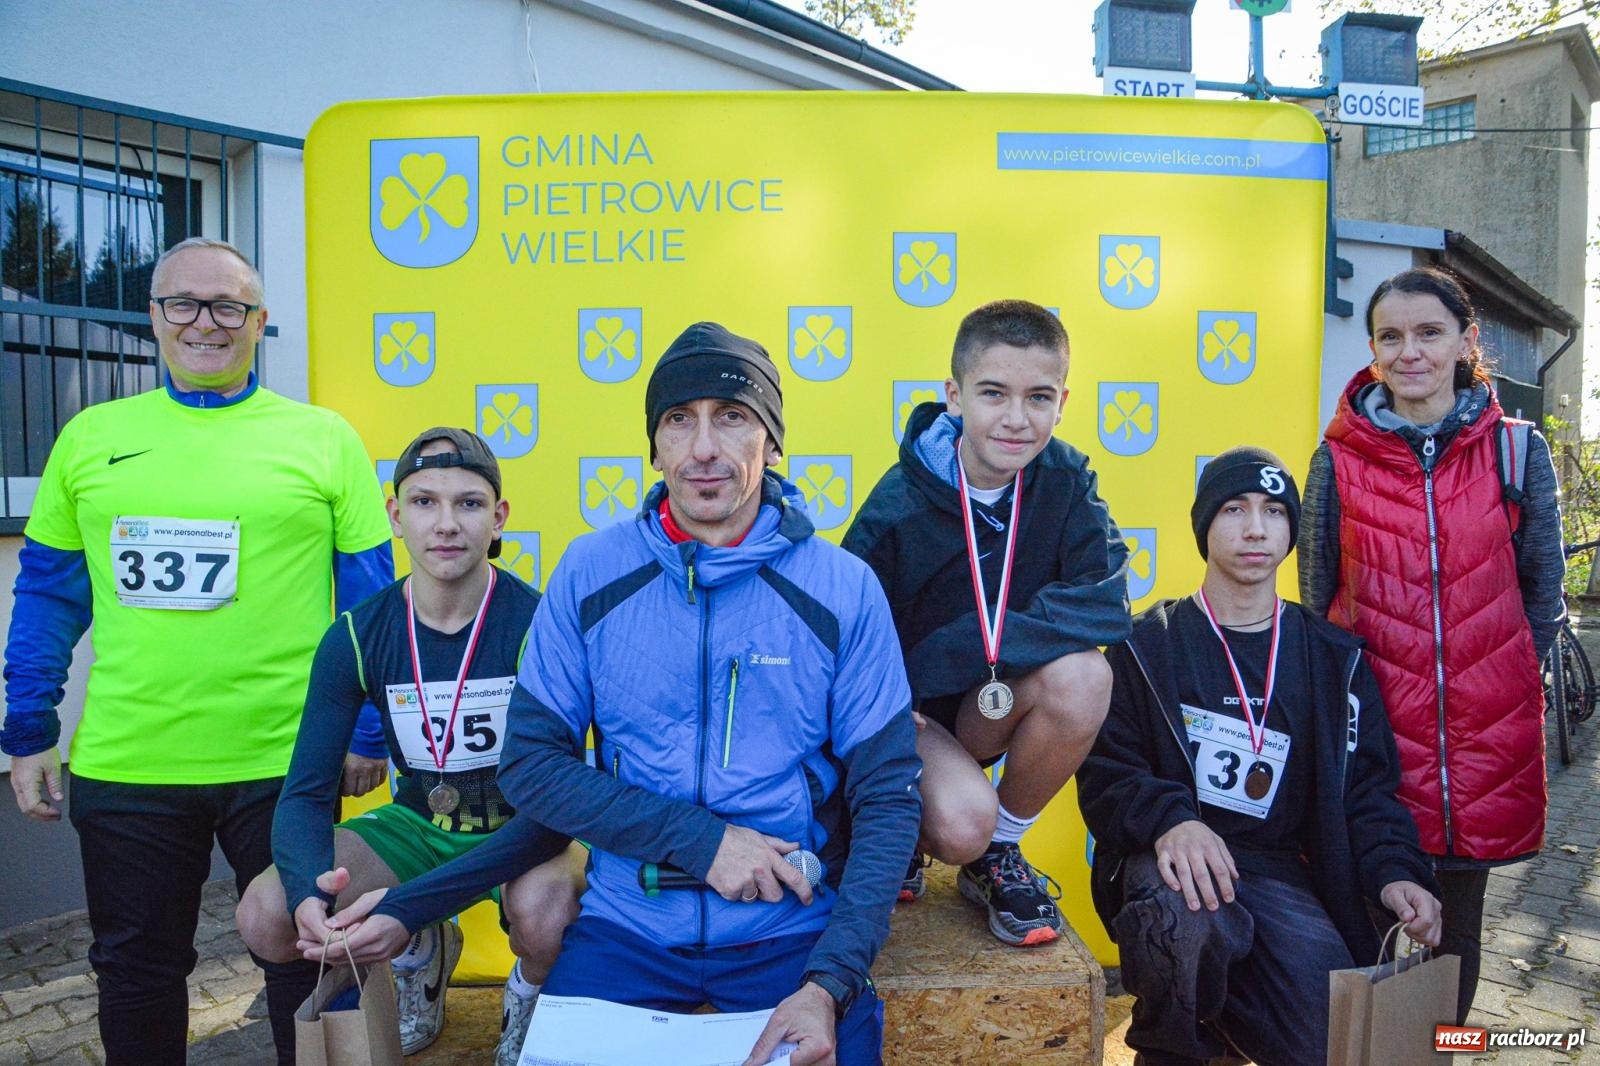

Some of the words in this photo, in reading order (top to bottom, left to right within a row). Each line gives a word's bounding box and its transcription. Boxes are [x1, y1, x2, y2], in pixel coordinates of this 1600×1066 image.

[1114, 79, 1185, 97] START
[1343, 90, 1420, 119] GOŚCIE
[501, 132, 654, 168] GMINA
[1003, 146, 1261, 169] www.pietrowicewielkie.com.pl
[503, 179, 784, 216] PIETROWICE
[501, 229, 686, 265] WIELKIE
[153, 527, 233, 539] www.personalbest.pl
[118, 550, 230, 593] 337
[434, 686, 513, 700] wwwersonalbest.pl
[421, 713, 498, 755] 95
[1218, 725, 1286, 751] www.persbest.pl
